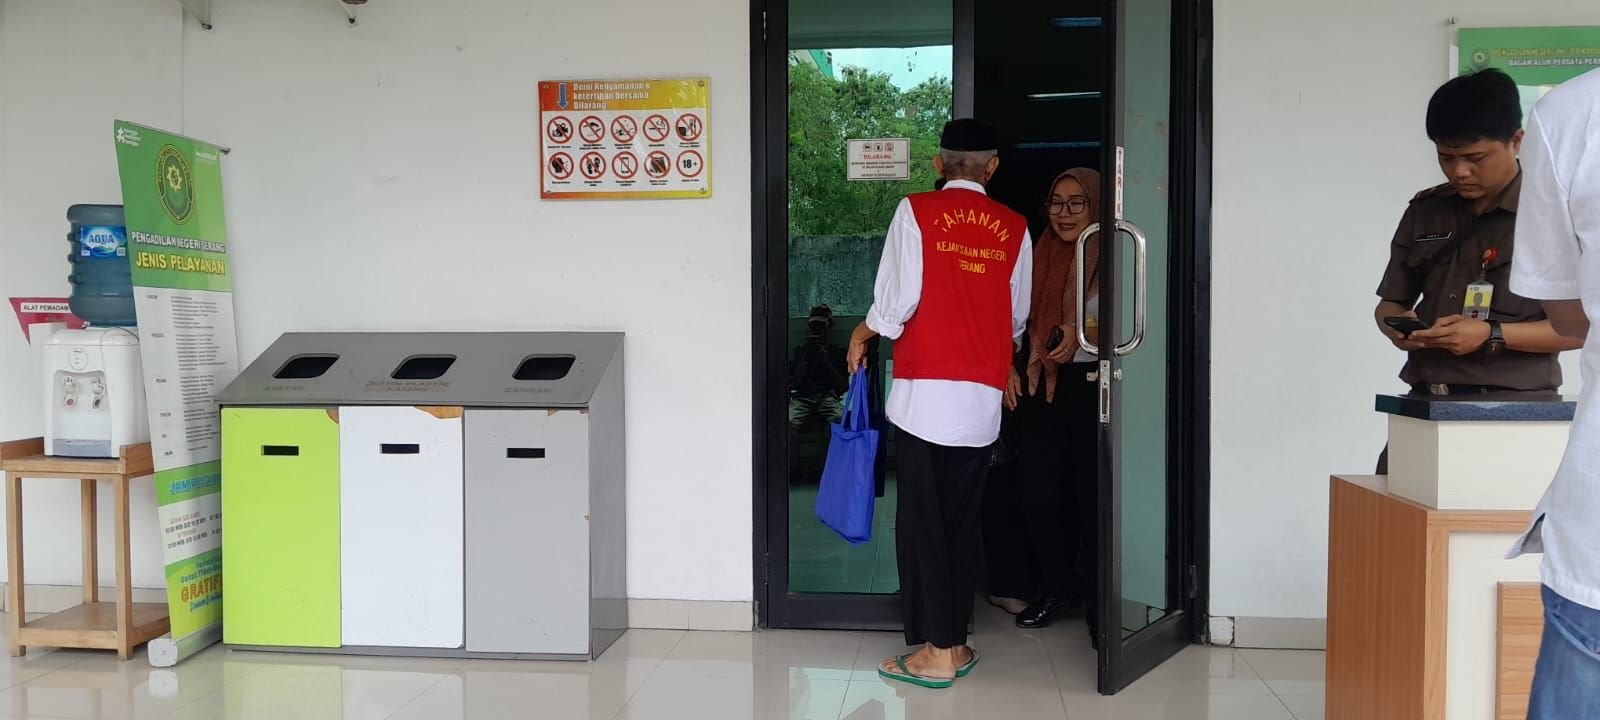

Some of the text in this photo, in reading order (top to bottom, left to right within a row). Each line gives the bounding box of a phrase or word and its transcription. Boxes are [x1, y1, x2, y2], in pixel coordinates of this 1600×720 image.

[89, 234, 115, 243] AQUA
[131, 231, 176, 246] PENGADILAN
[980, 248, 1007, 261] NEGERI
[136, 251, 225, 274] JENIS PELAYANAN
